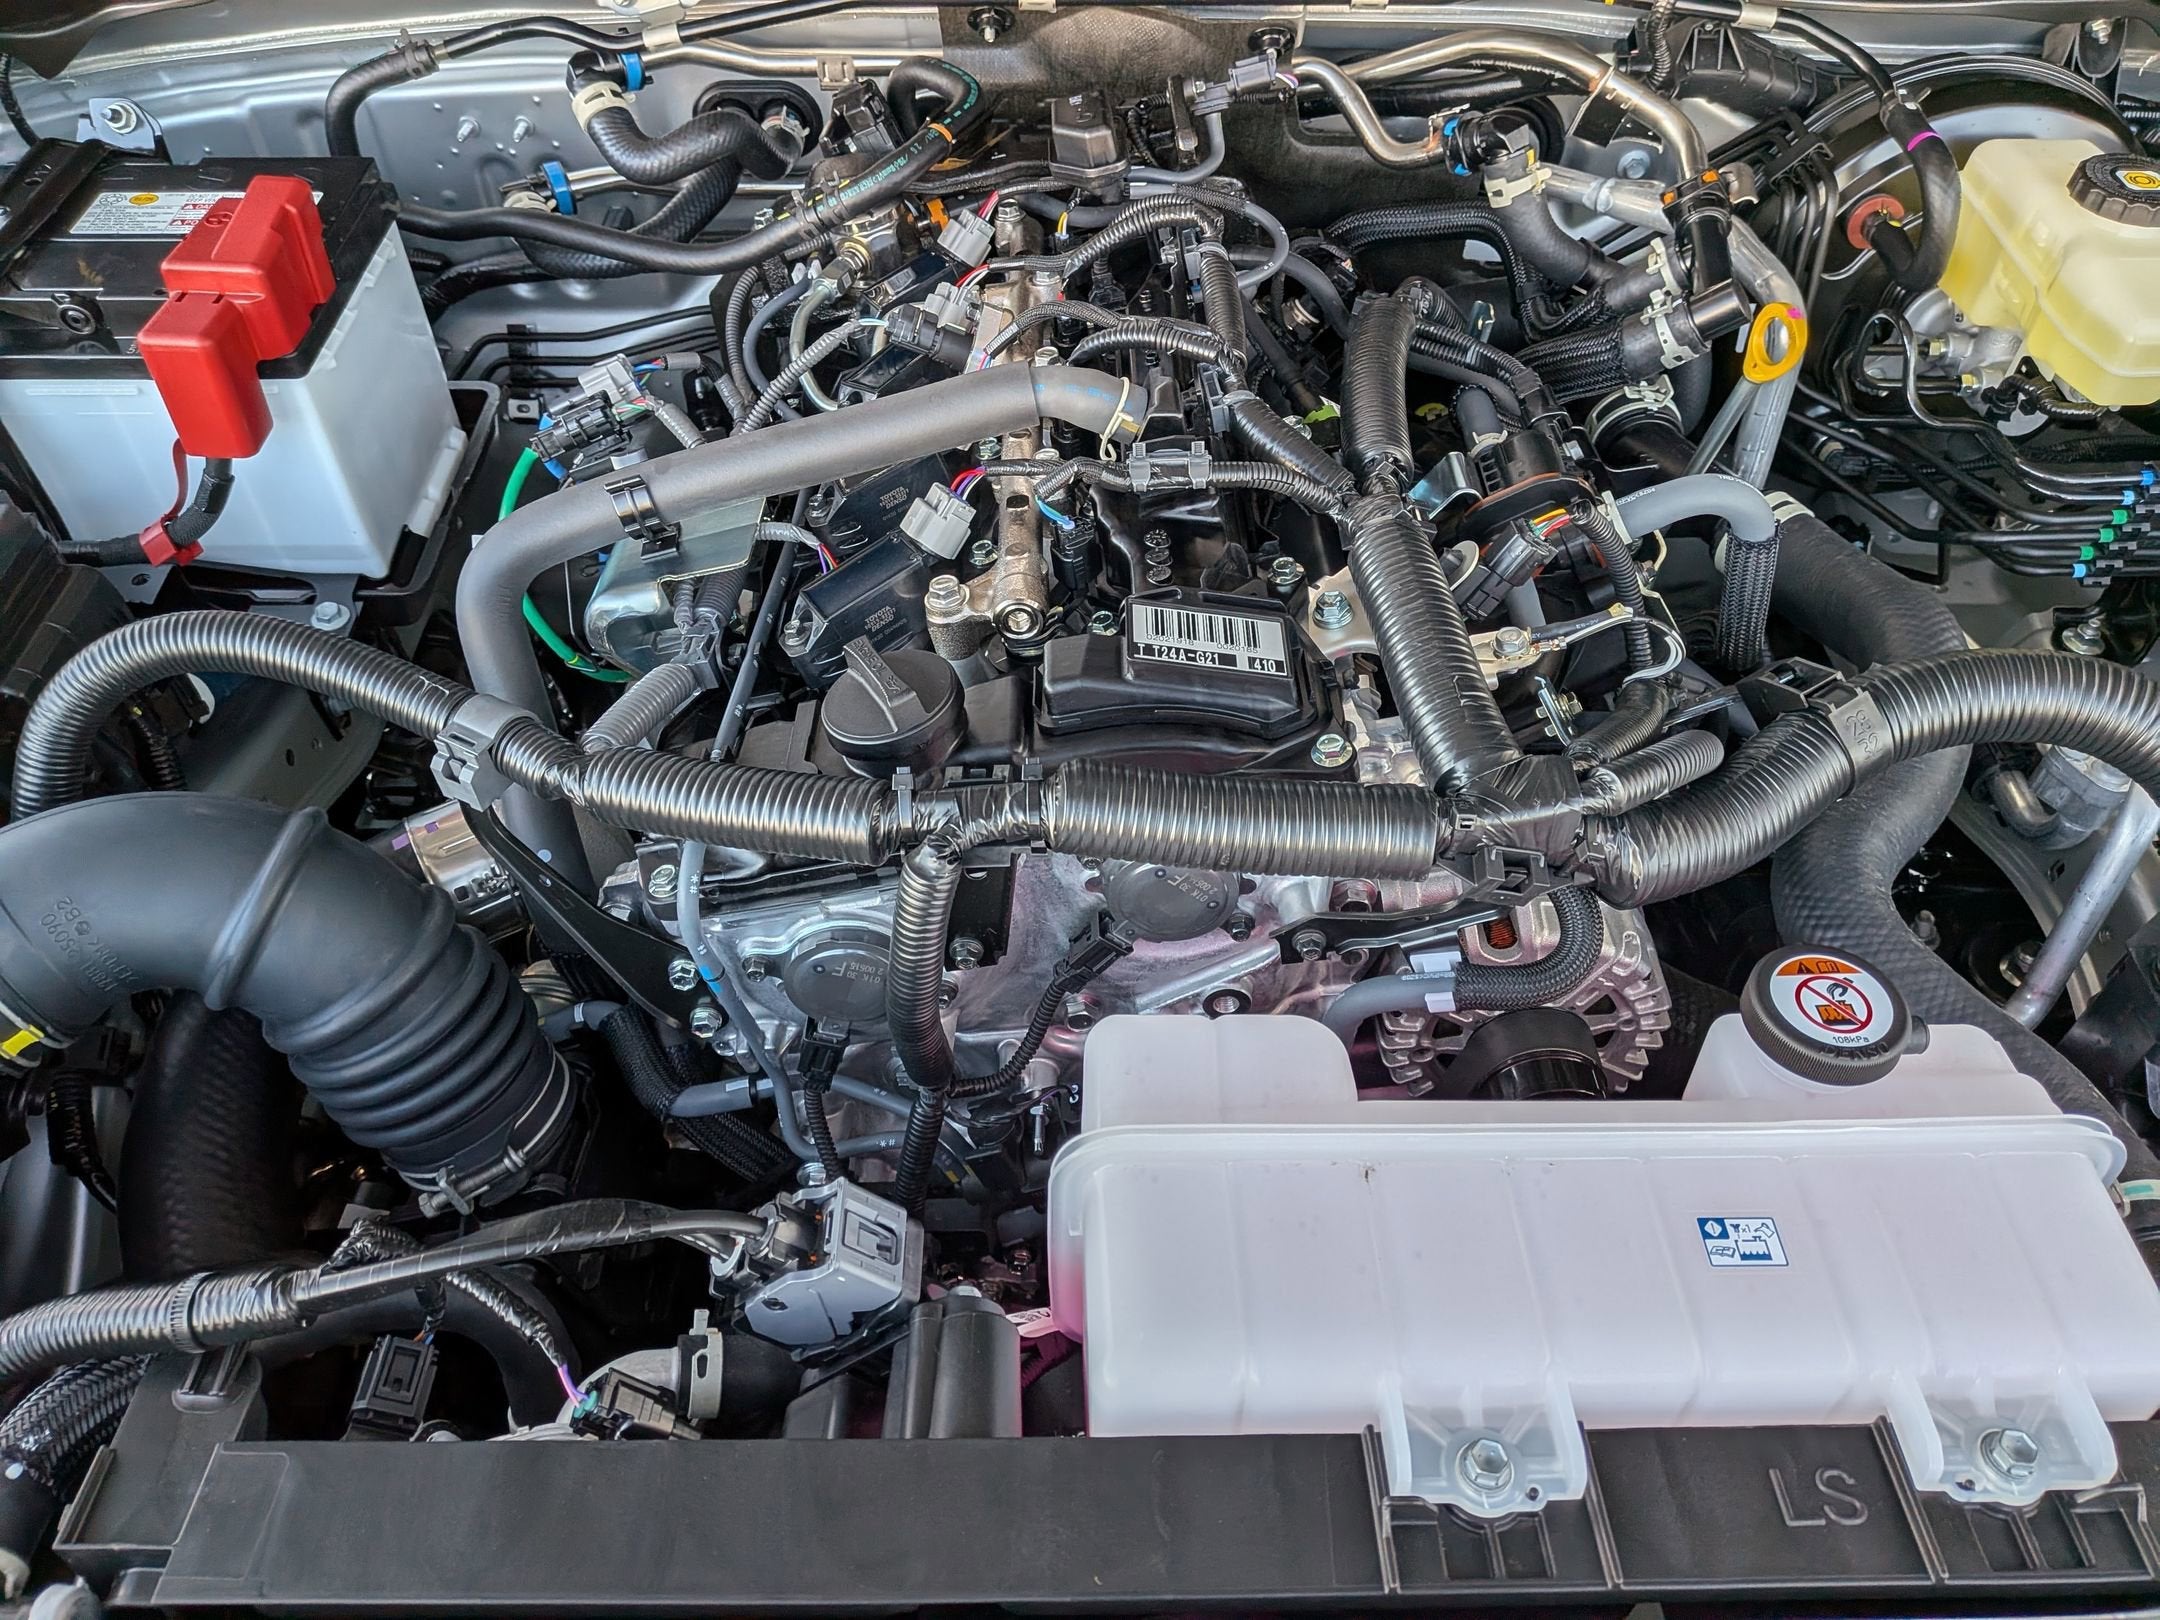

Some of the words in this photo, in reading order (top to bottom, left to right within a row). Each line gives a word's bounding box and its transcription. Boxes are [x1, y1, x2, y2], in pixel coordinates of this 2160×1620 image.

[880, 486, 905, 501] TOYOTA
[886, 494, 908, 509] DENSO
[865, 605, 892, 624] TOYOTA
[872, 614, 895, 632] DENSO
[1137, 643, 1146, 656] T
[1152, 645, 1220, 666] T24A-G21
[1253, 658, 1277, 673] 410
[831, 962, 848, 977] F
[1832, 1035, 1870, 1045] 108kPa
[1821, 1041, 1890, 1060] DENSO
[1768, 1466, 1869, 1527] LS
